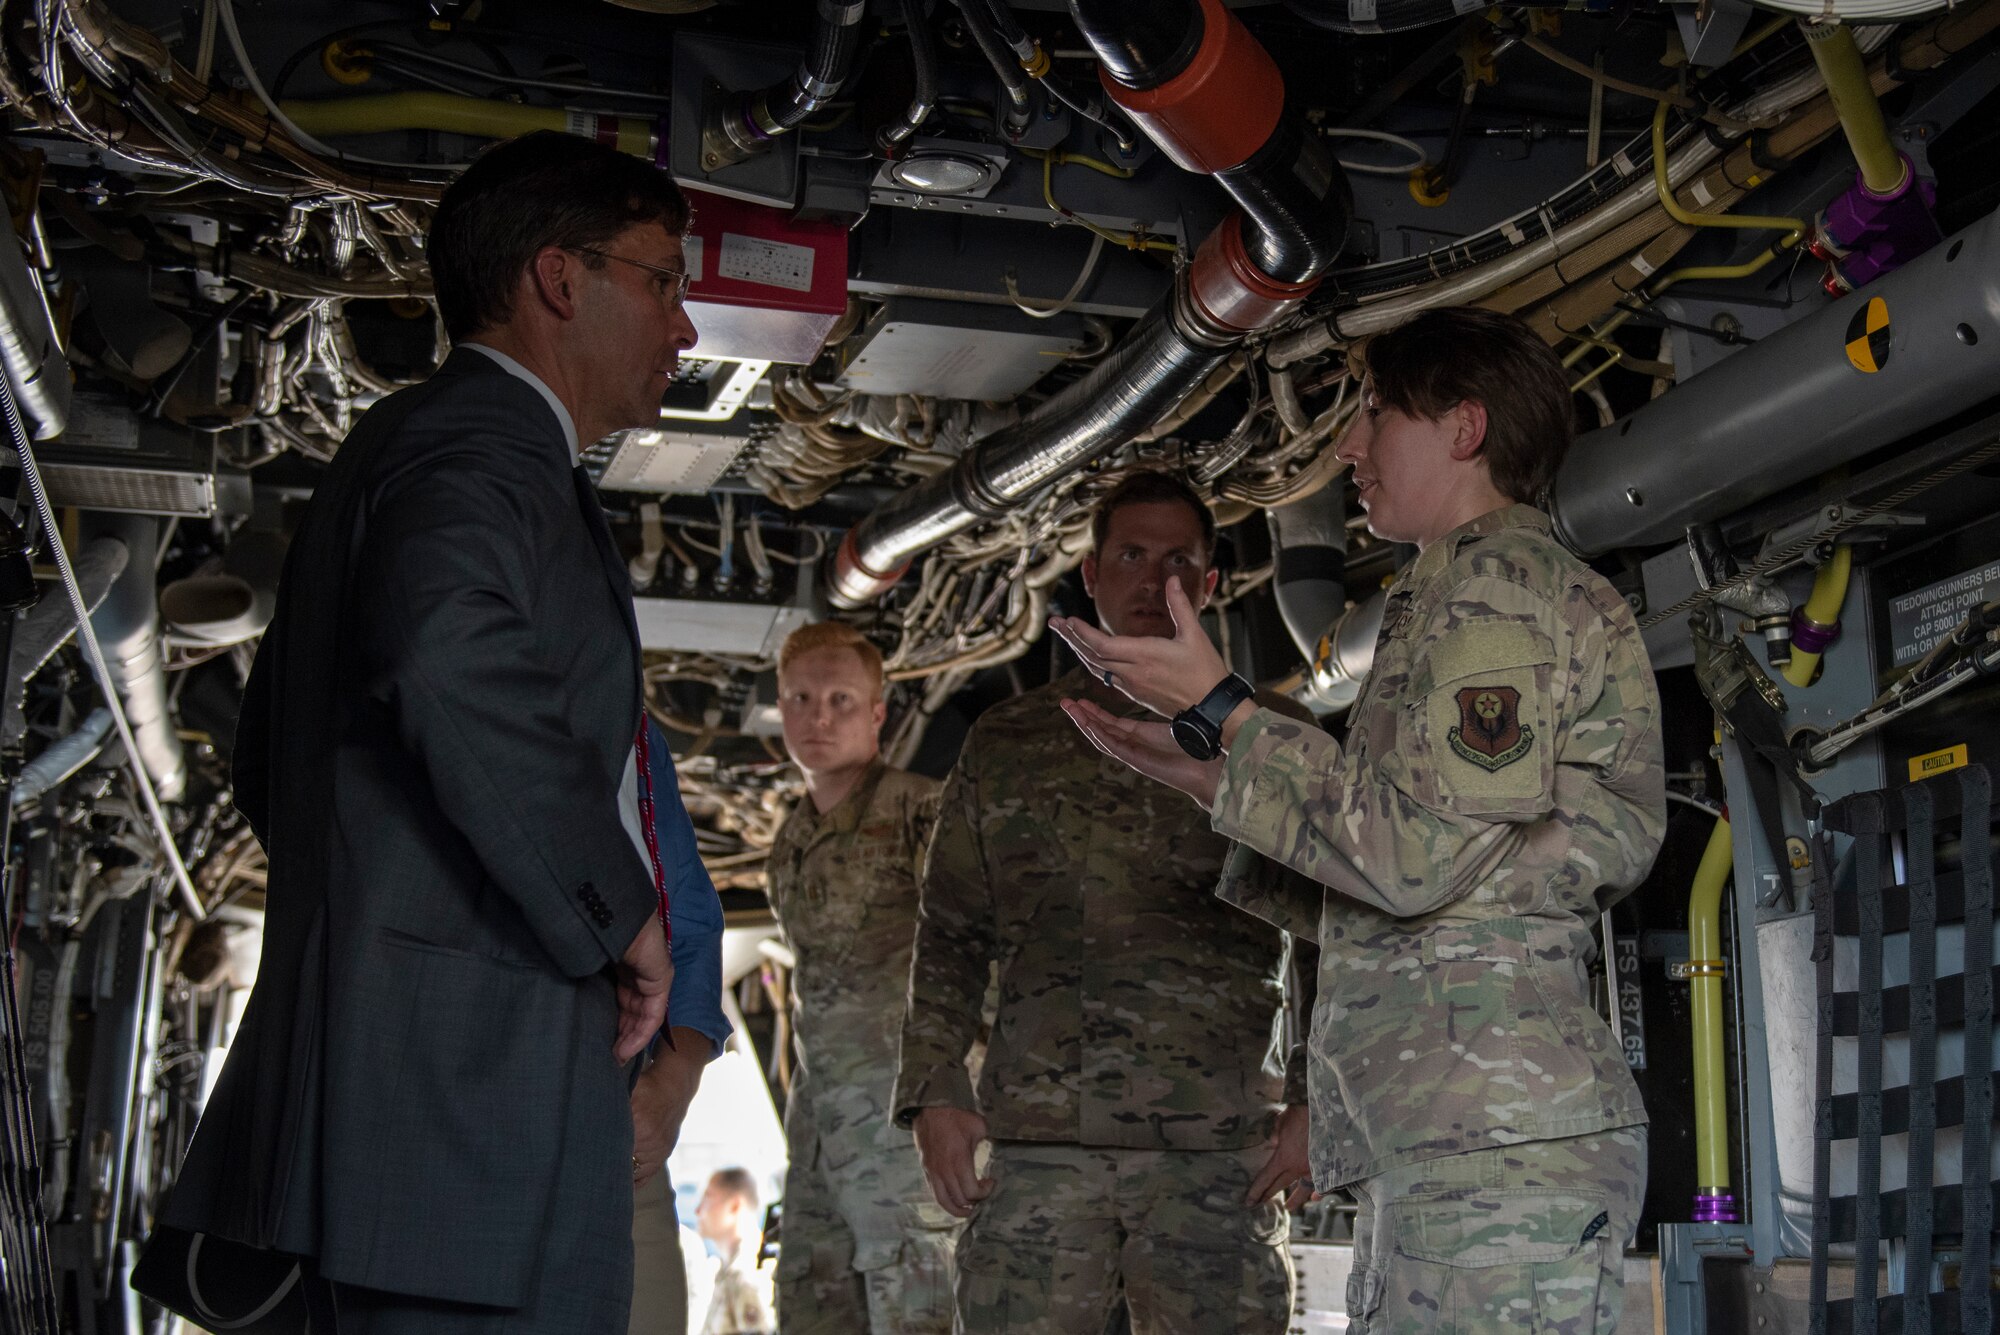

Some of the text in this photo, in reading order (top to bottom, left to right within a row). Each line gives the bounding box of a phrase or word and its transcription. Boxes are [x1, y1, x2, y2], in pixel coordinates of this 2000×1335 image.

[1895, 572, 1983, 613] TIEDOWN/GUNNERS
[1920, 587, 1984, 621] ATTACH POINT
[1913, 622, 1932, 639] CAP
[1934, 615, 1954, 632] 5000
[1895, 638, 1933, 661] WITH OR
[1924, 753, 1951, 770] CAUTION
[1617, 939, 1644, 1066] FS 437.65
